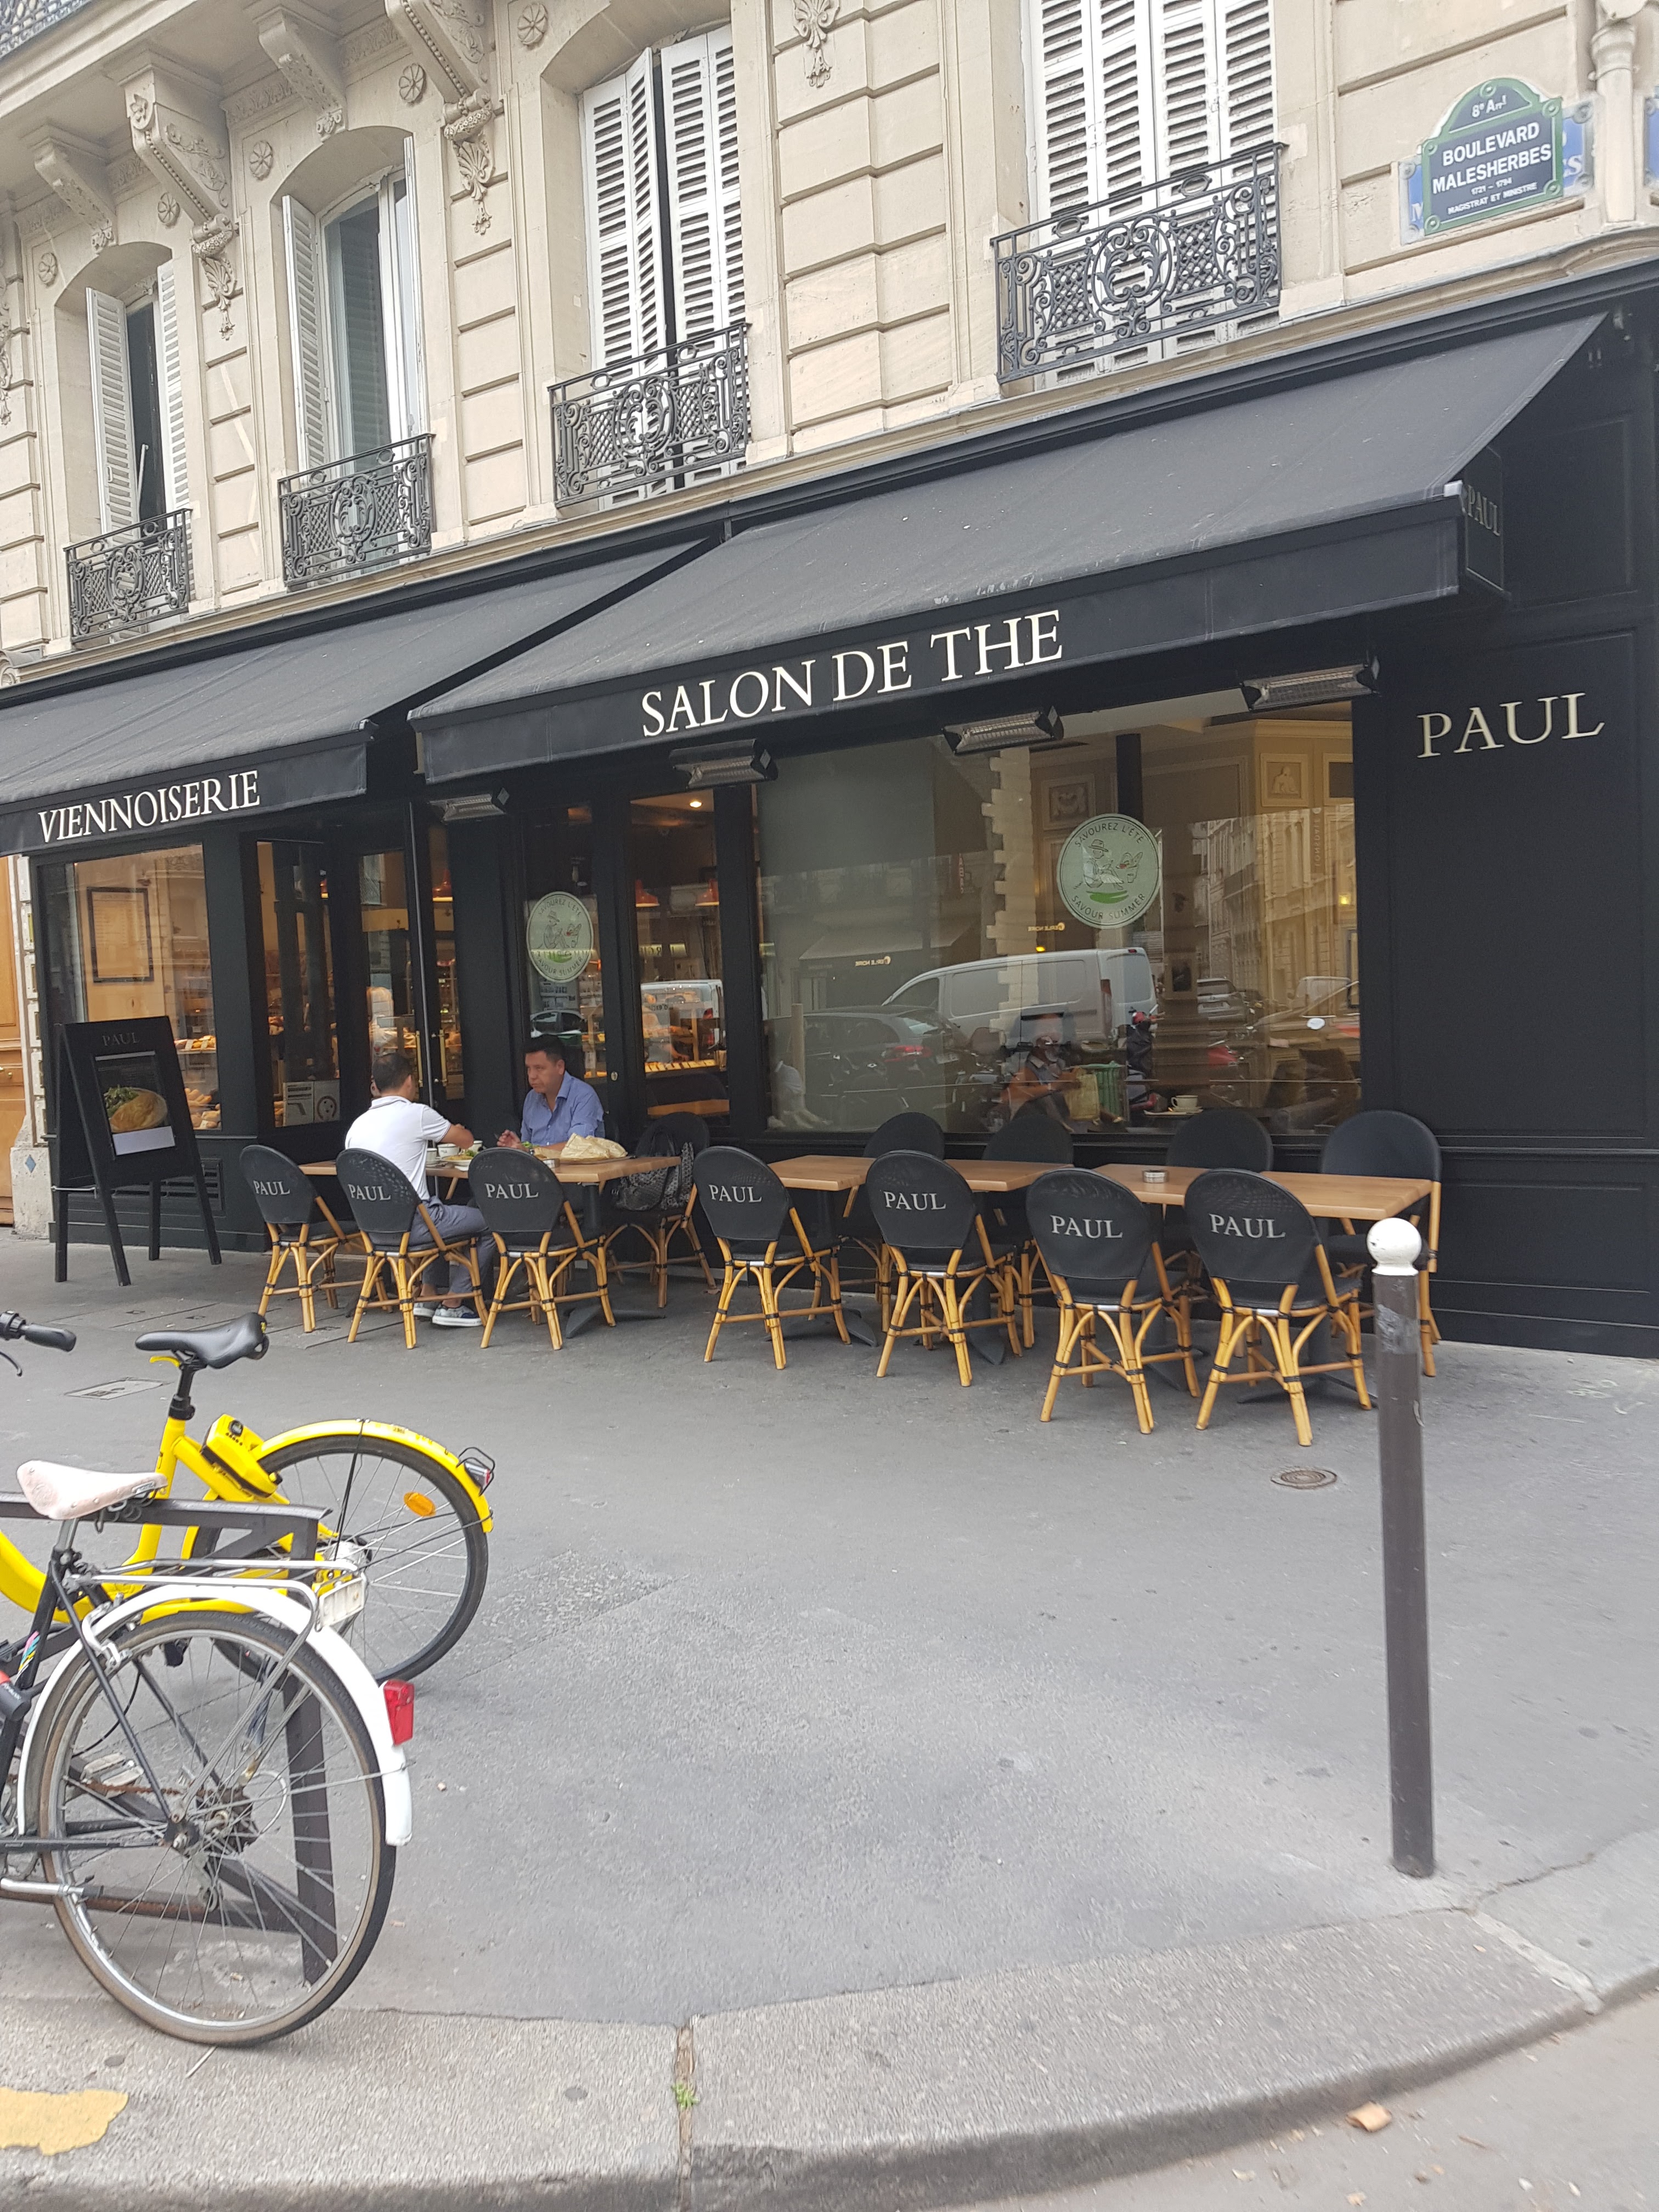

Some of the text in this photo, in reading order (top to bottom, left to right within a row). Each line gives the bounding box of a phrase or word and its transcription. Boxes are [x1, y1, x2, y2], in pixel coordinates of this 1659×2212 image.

[1442, 121, 1540, 166] BOULEVARD
[1432, 143, 1552, 194] MALESHERBES
[1447, 182, 1538, 215] MAGISTRAT ET MINISTRE
[1471, 185, 1486, 195] 1721
[1468, 484, 1501, 537] PAUL
[642, 609, 1063, 737] SALON DE THE
[1417, 692, 1606, 758] PAUL
[38, 770, 260, 843] VIENNOISERIE
[1074, 822, 1145, 848] SAVOUREZ L'ÉTÉ
[1071, 893, 1146, 921] SAVOUR SUMMER
[559, 957, 583, 975] SUMMER
[102, 1032, 139, 1046] PAUL
[253, 1180, 290, 1196] PAUL
[348, 1184, 391, 1201] PAUL
[485, 1183, 538, 1200] PAUL
[708, 1184, 762, 1203] PAUL
[883, 1191, 947, 1211] PAUL
[1050, 1215, 1124, 1239] PAUL
[1209, 1213, 1286, 1239] PAUL
